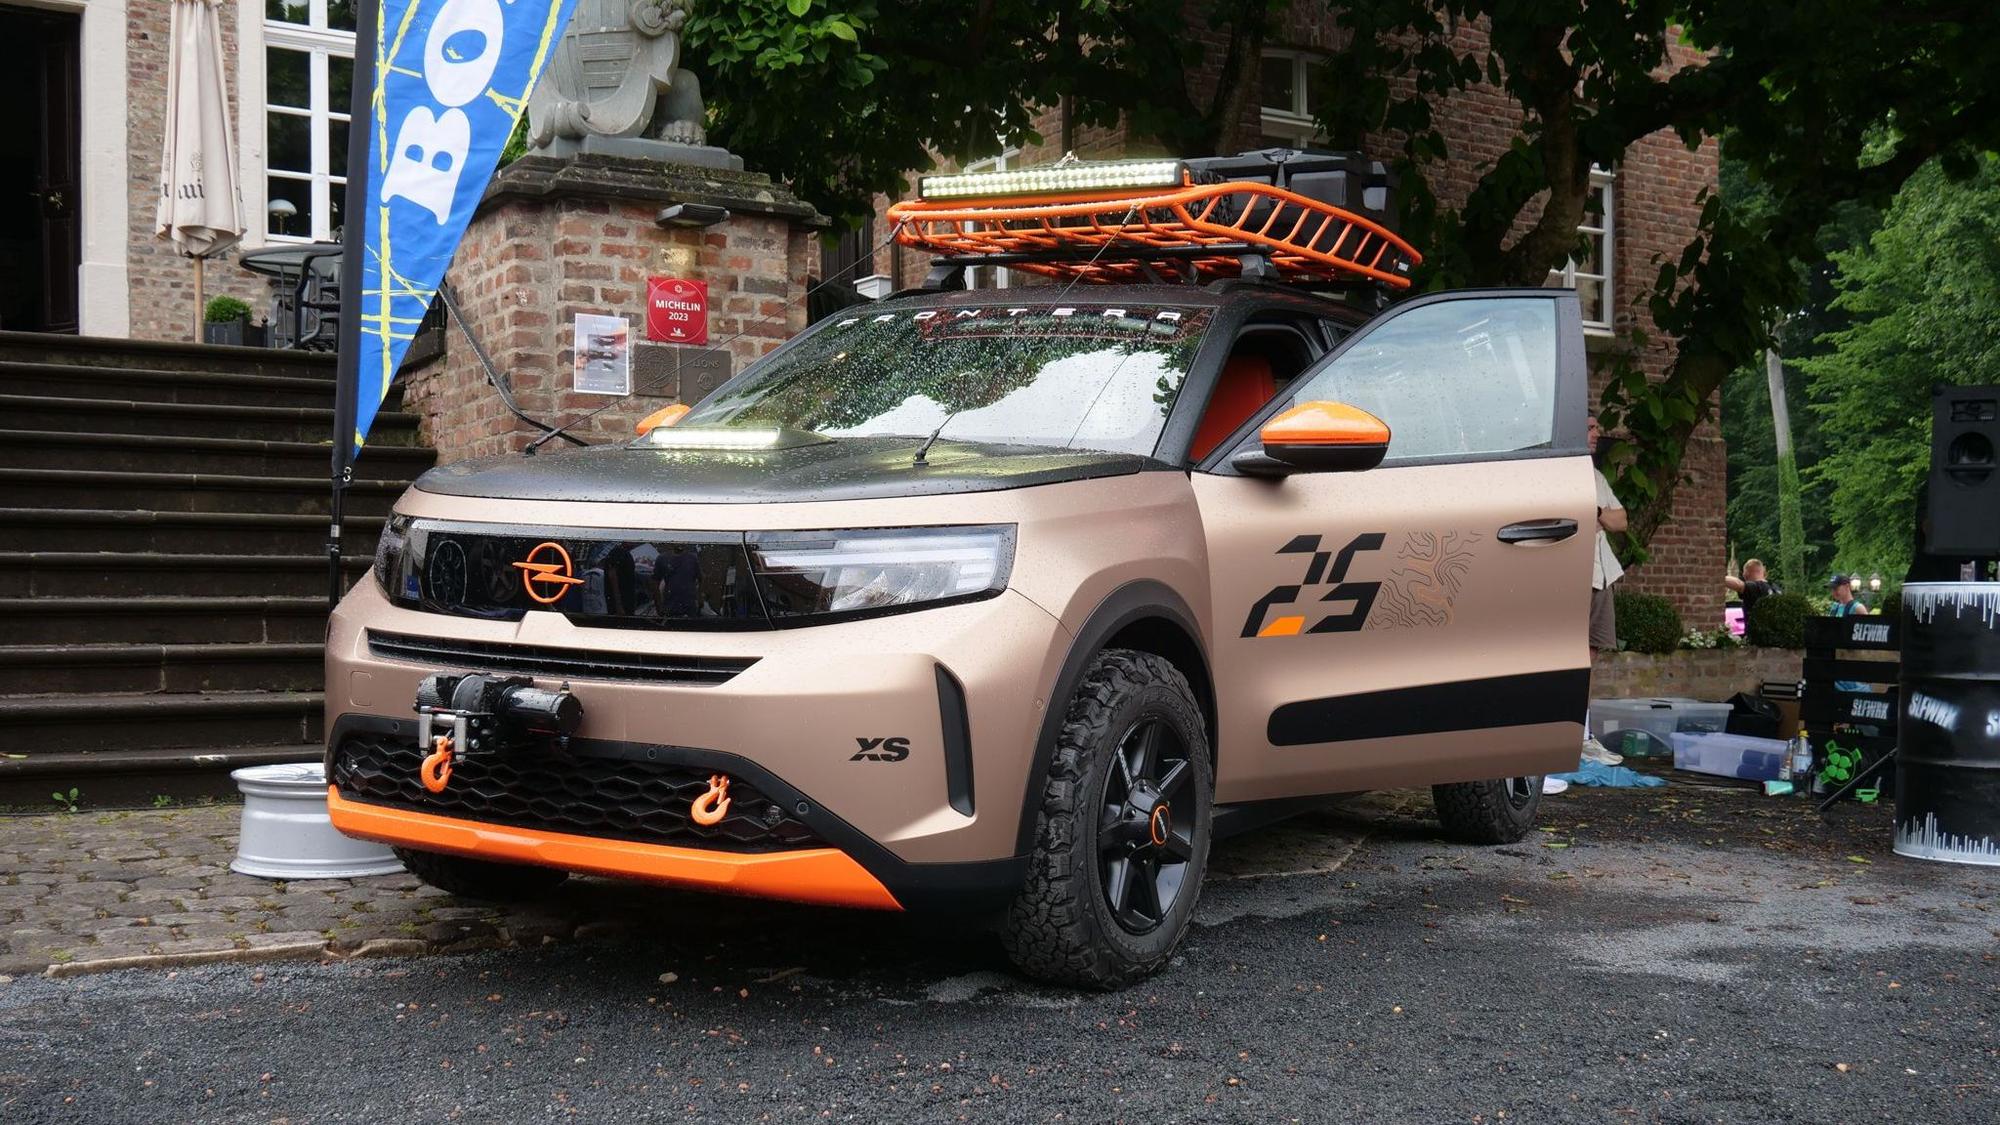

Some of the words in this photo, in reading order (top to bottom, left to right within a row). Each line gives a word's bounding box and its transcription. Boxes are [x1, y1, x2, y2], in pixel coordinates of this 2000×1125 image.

[381, 0, 516, 226] BO
[655, 299, 701, 312] MICHELIN
[668, 311, 689, 321] 2023
[836, 307, 1182, 328] FRONTERA
[1852, 623, 1890, 643] SLFWRK
[1851, 699, 1889, 720] SLFWRK
[848, 736, 911, 762] XS
